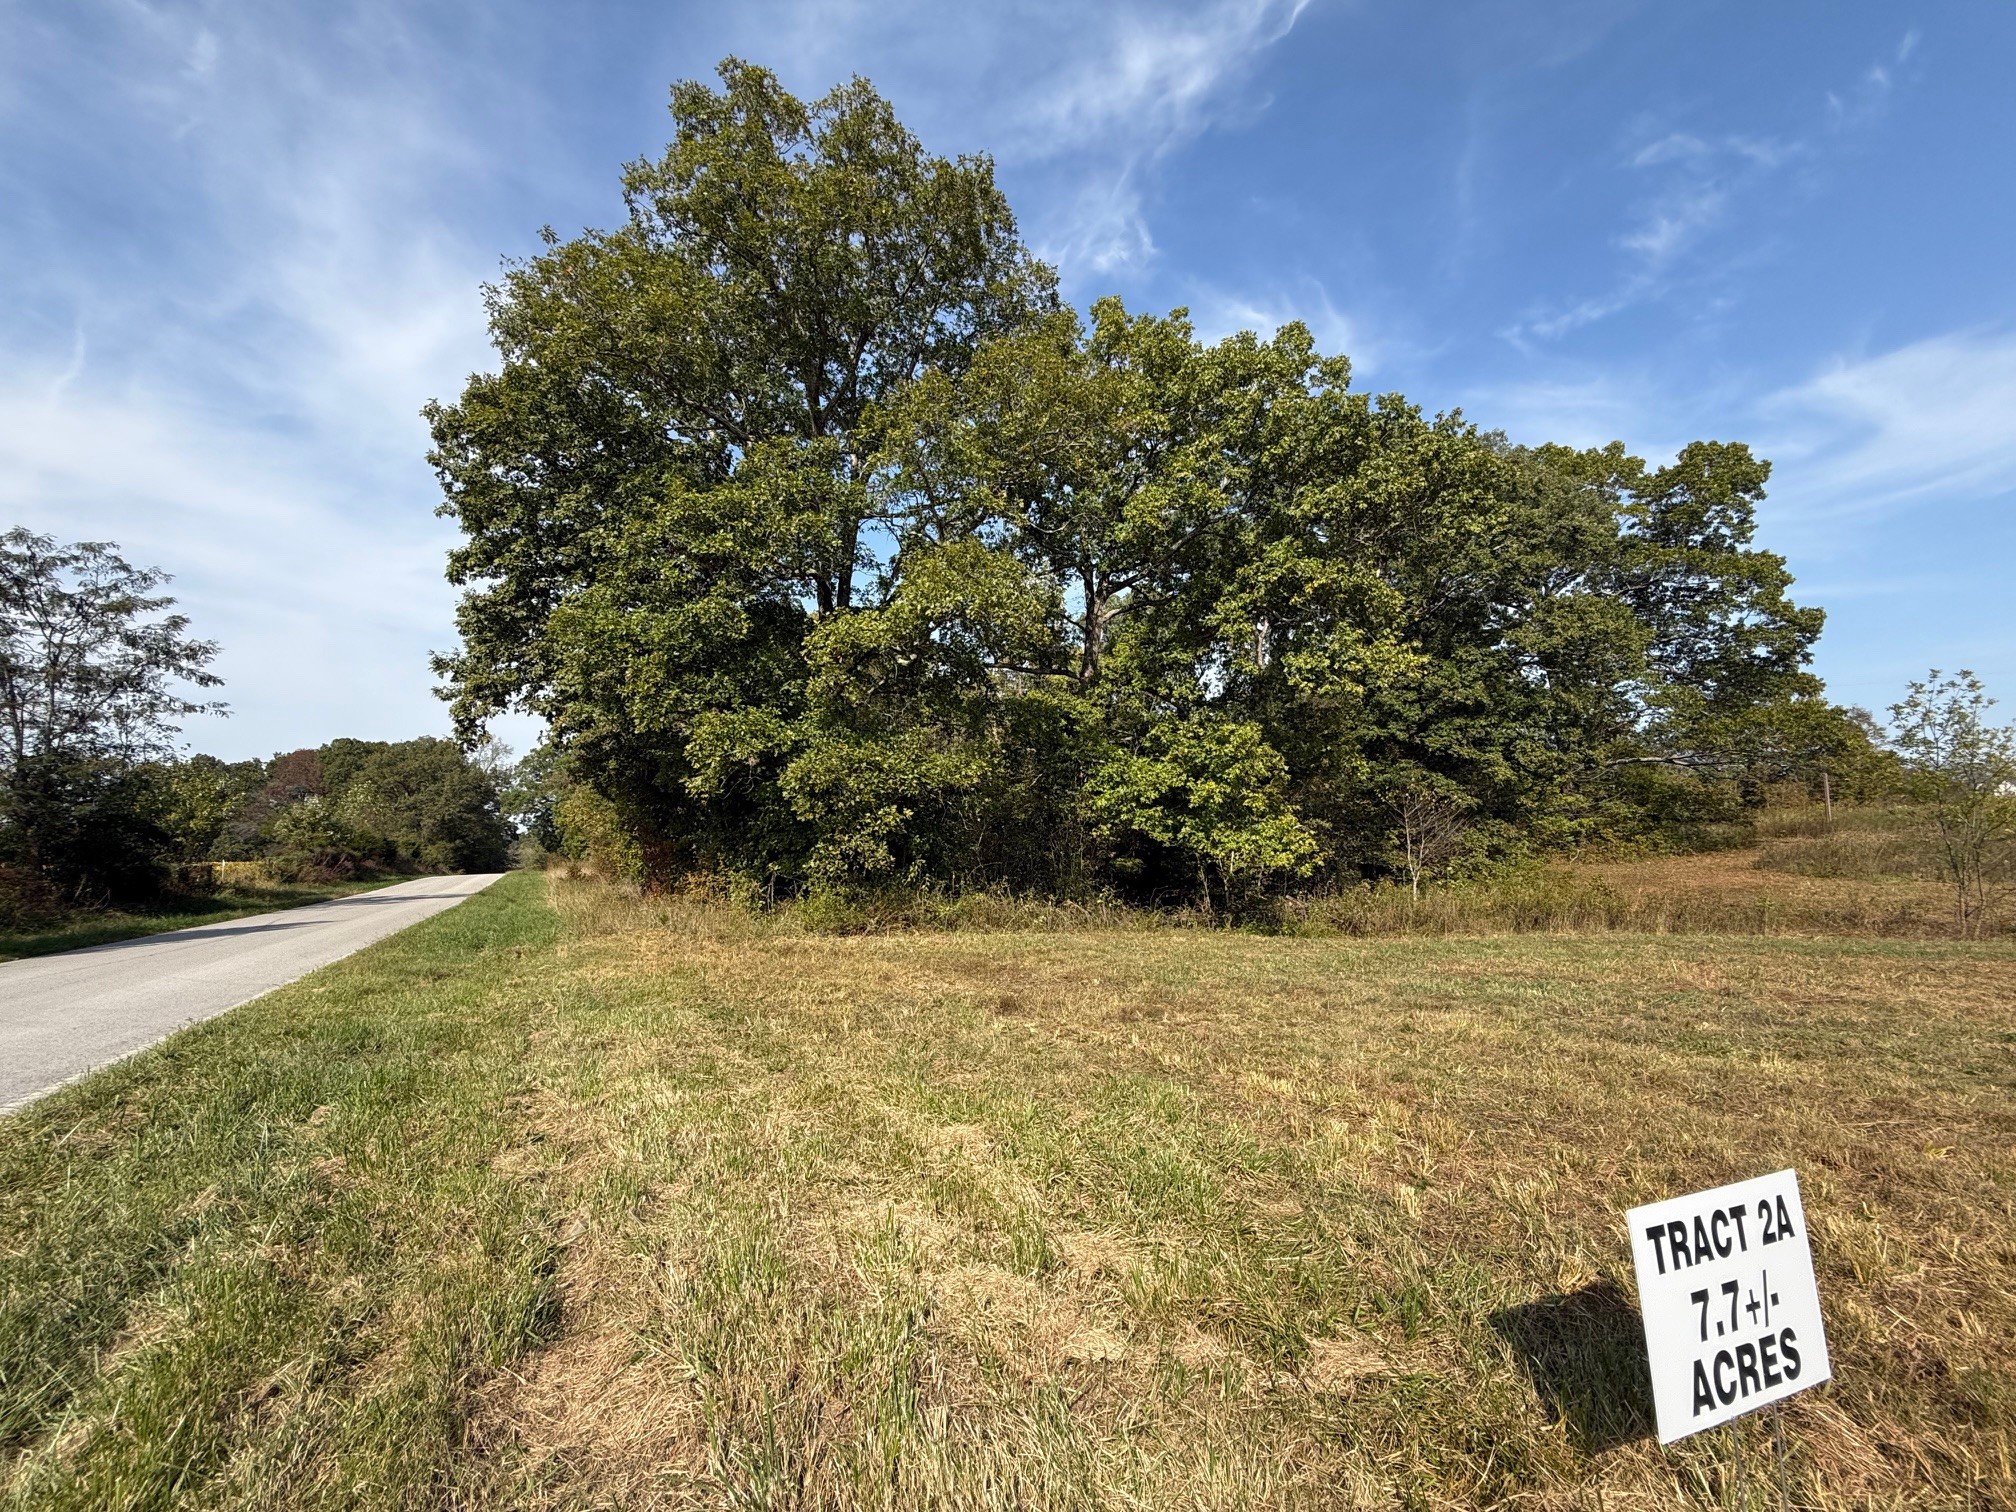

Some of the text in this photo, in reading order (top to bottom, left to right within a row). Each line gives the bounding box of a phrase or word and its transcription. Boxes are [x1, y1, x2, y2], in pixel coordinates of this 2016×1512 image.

[1645, 1194, 1796, 1275] TRACT 2A
[1690, 1269, 1780, 1342] 7.7+/-
[1692, 1327, 1802, 1418] ACRES
